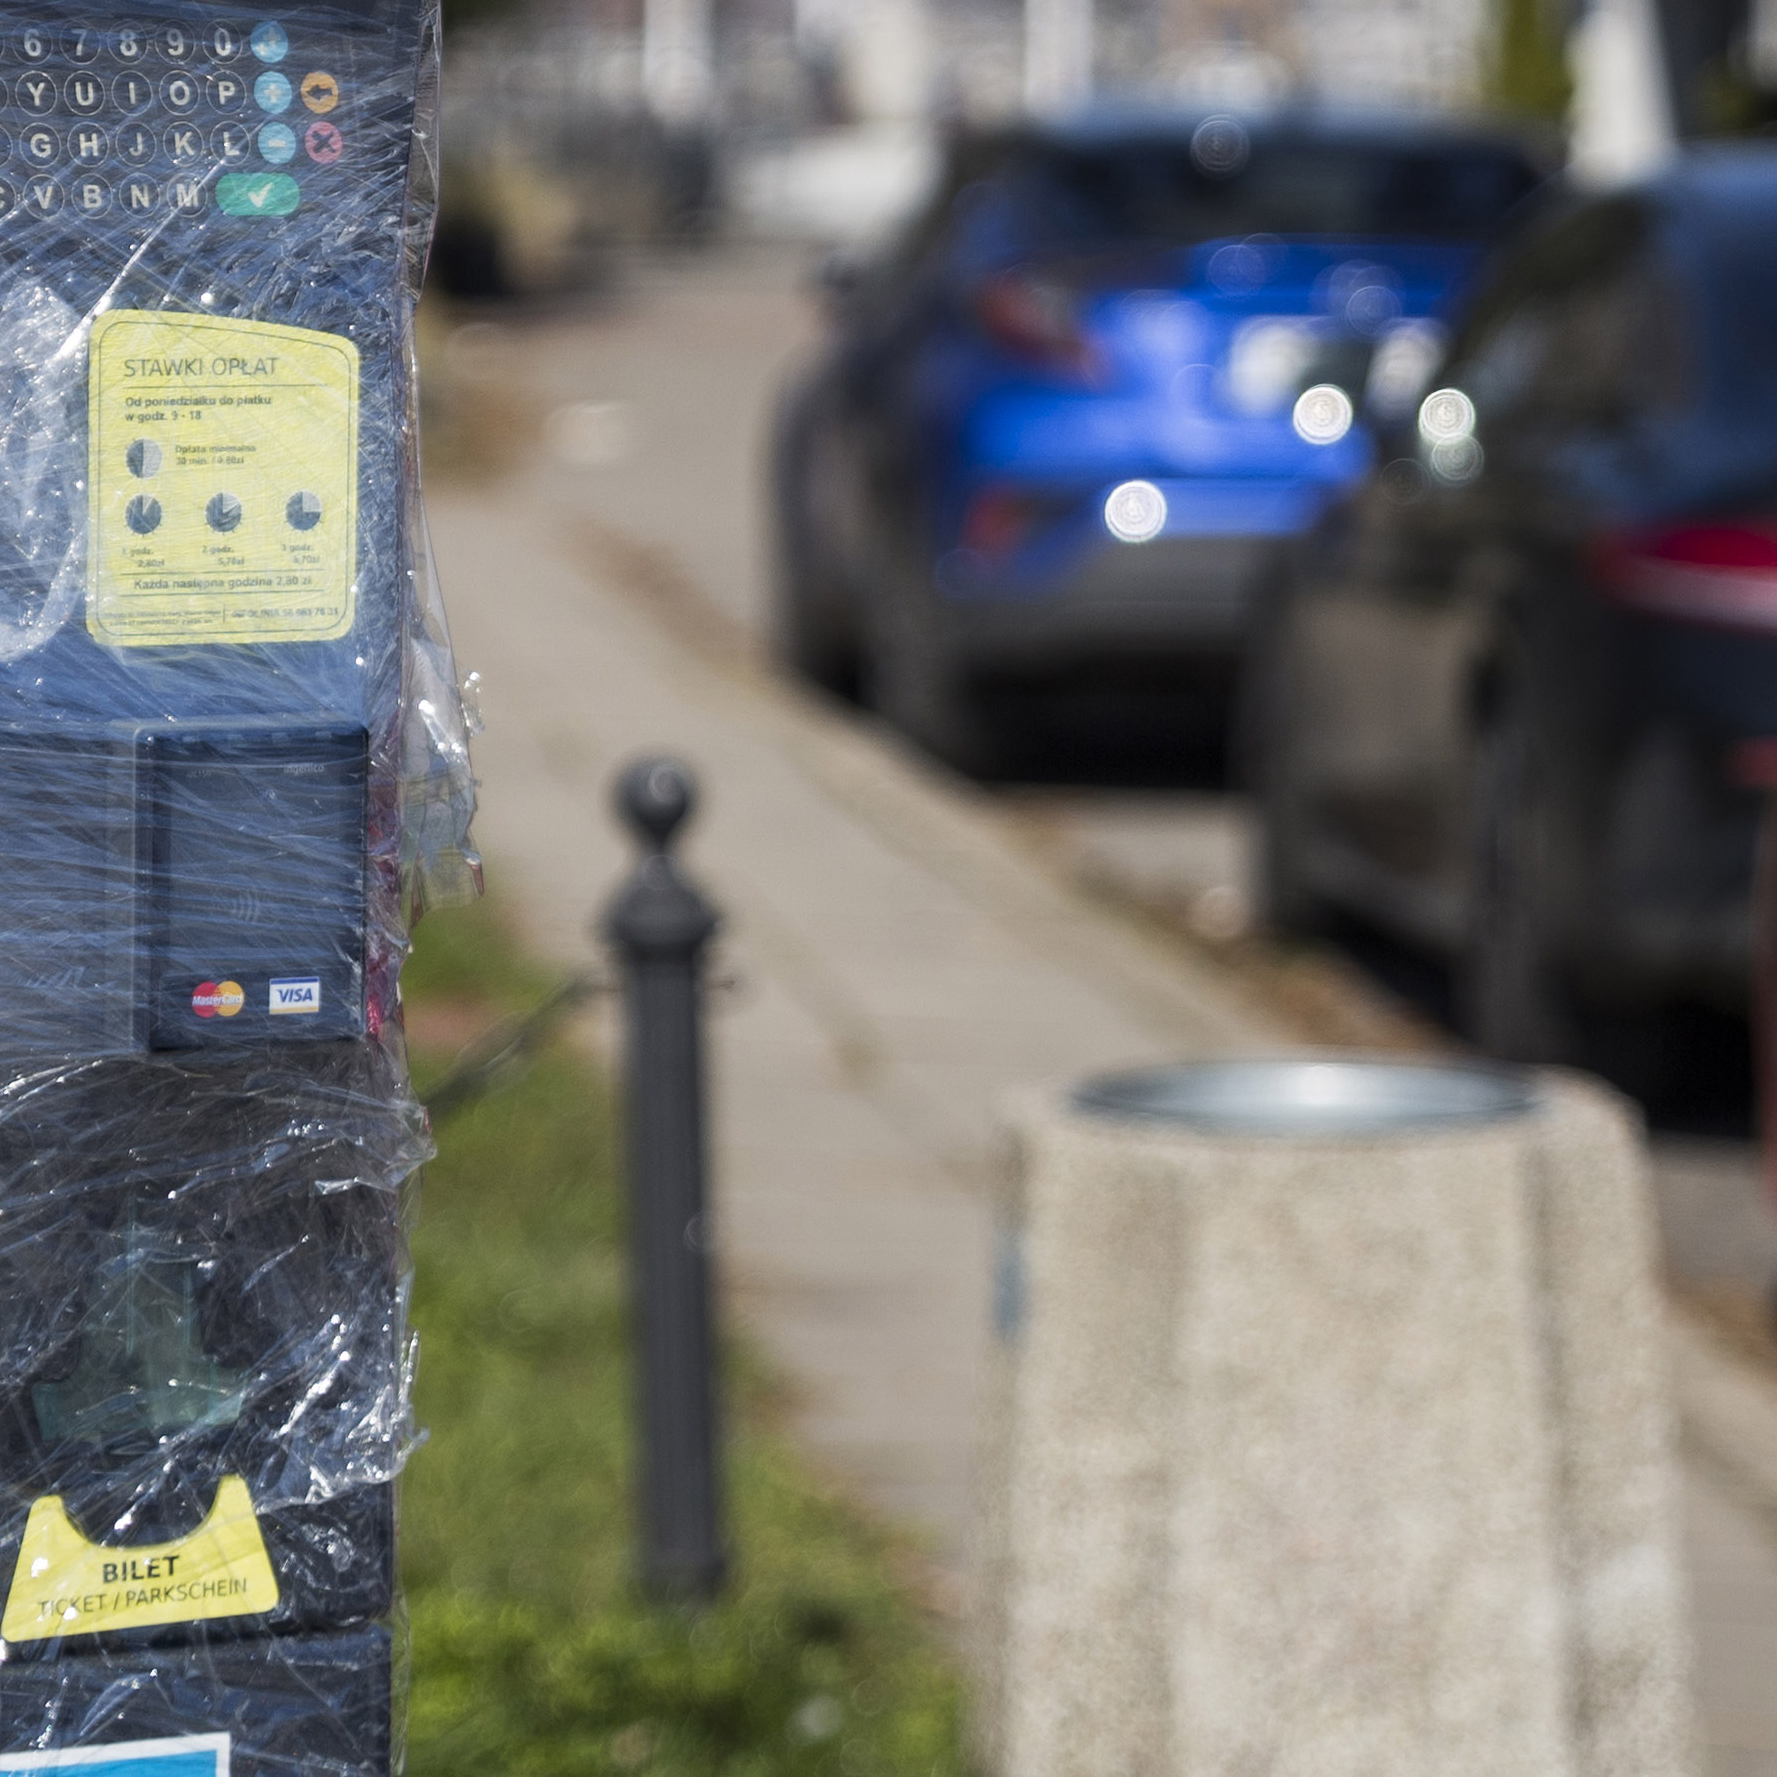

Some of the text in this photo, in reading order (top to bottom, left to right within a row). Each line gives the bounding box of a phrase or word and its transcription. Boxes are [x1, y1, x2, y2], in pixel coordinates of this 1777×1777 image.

[24, 28, 42, 57] 6
[72, 28, 88, 57] 7
[119, 28, 138, 57] 8
[166, 28, 185, 57] 9
[214, 28, 232, 57] 0
[26, 82, 45, 107] Y
[74, 82, 95, 106] U
[128, 81, 136, 105] I
[168, 80, 191, 106] O
[218, 80, 236, 105] P
[30, 133, 52, 159] G
[78, 132, 100, 158] H
[128, 132, 143, 157] J
[174, 132, 196, 157] K
[222, 131, 240, 157] L
[33, 186, 53, 210] V
[82, 184, 103, 209] B
[130, 184, 150, 209] N
[176, 183, 199, 208] M
[124, 357, 279, 378] STAWKI OPŁAT
[125, 396, 142, 408] Od
[145, 396, 216, 409] poniedziałku
[221, 396, 234, 406] do
[125, 412, 134, 421] w
[138, 410, 168, 423] godz.
[172, 411, 178, 421] 9
[190, 411, 202, 421] 18
[134, 579, 169, 590] Każda
[228, 578, 272, 590] godzina
[192, 994, 243, 1007] MasterCard
[276, 988, 313, 1003] VISA
[102, 1555, 181, 1584] BILET
[38, 1593, 107, 1617] TICKET
[125, 1578, 247, 1608] PARKSCHEIN
